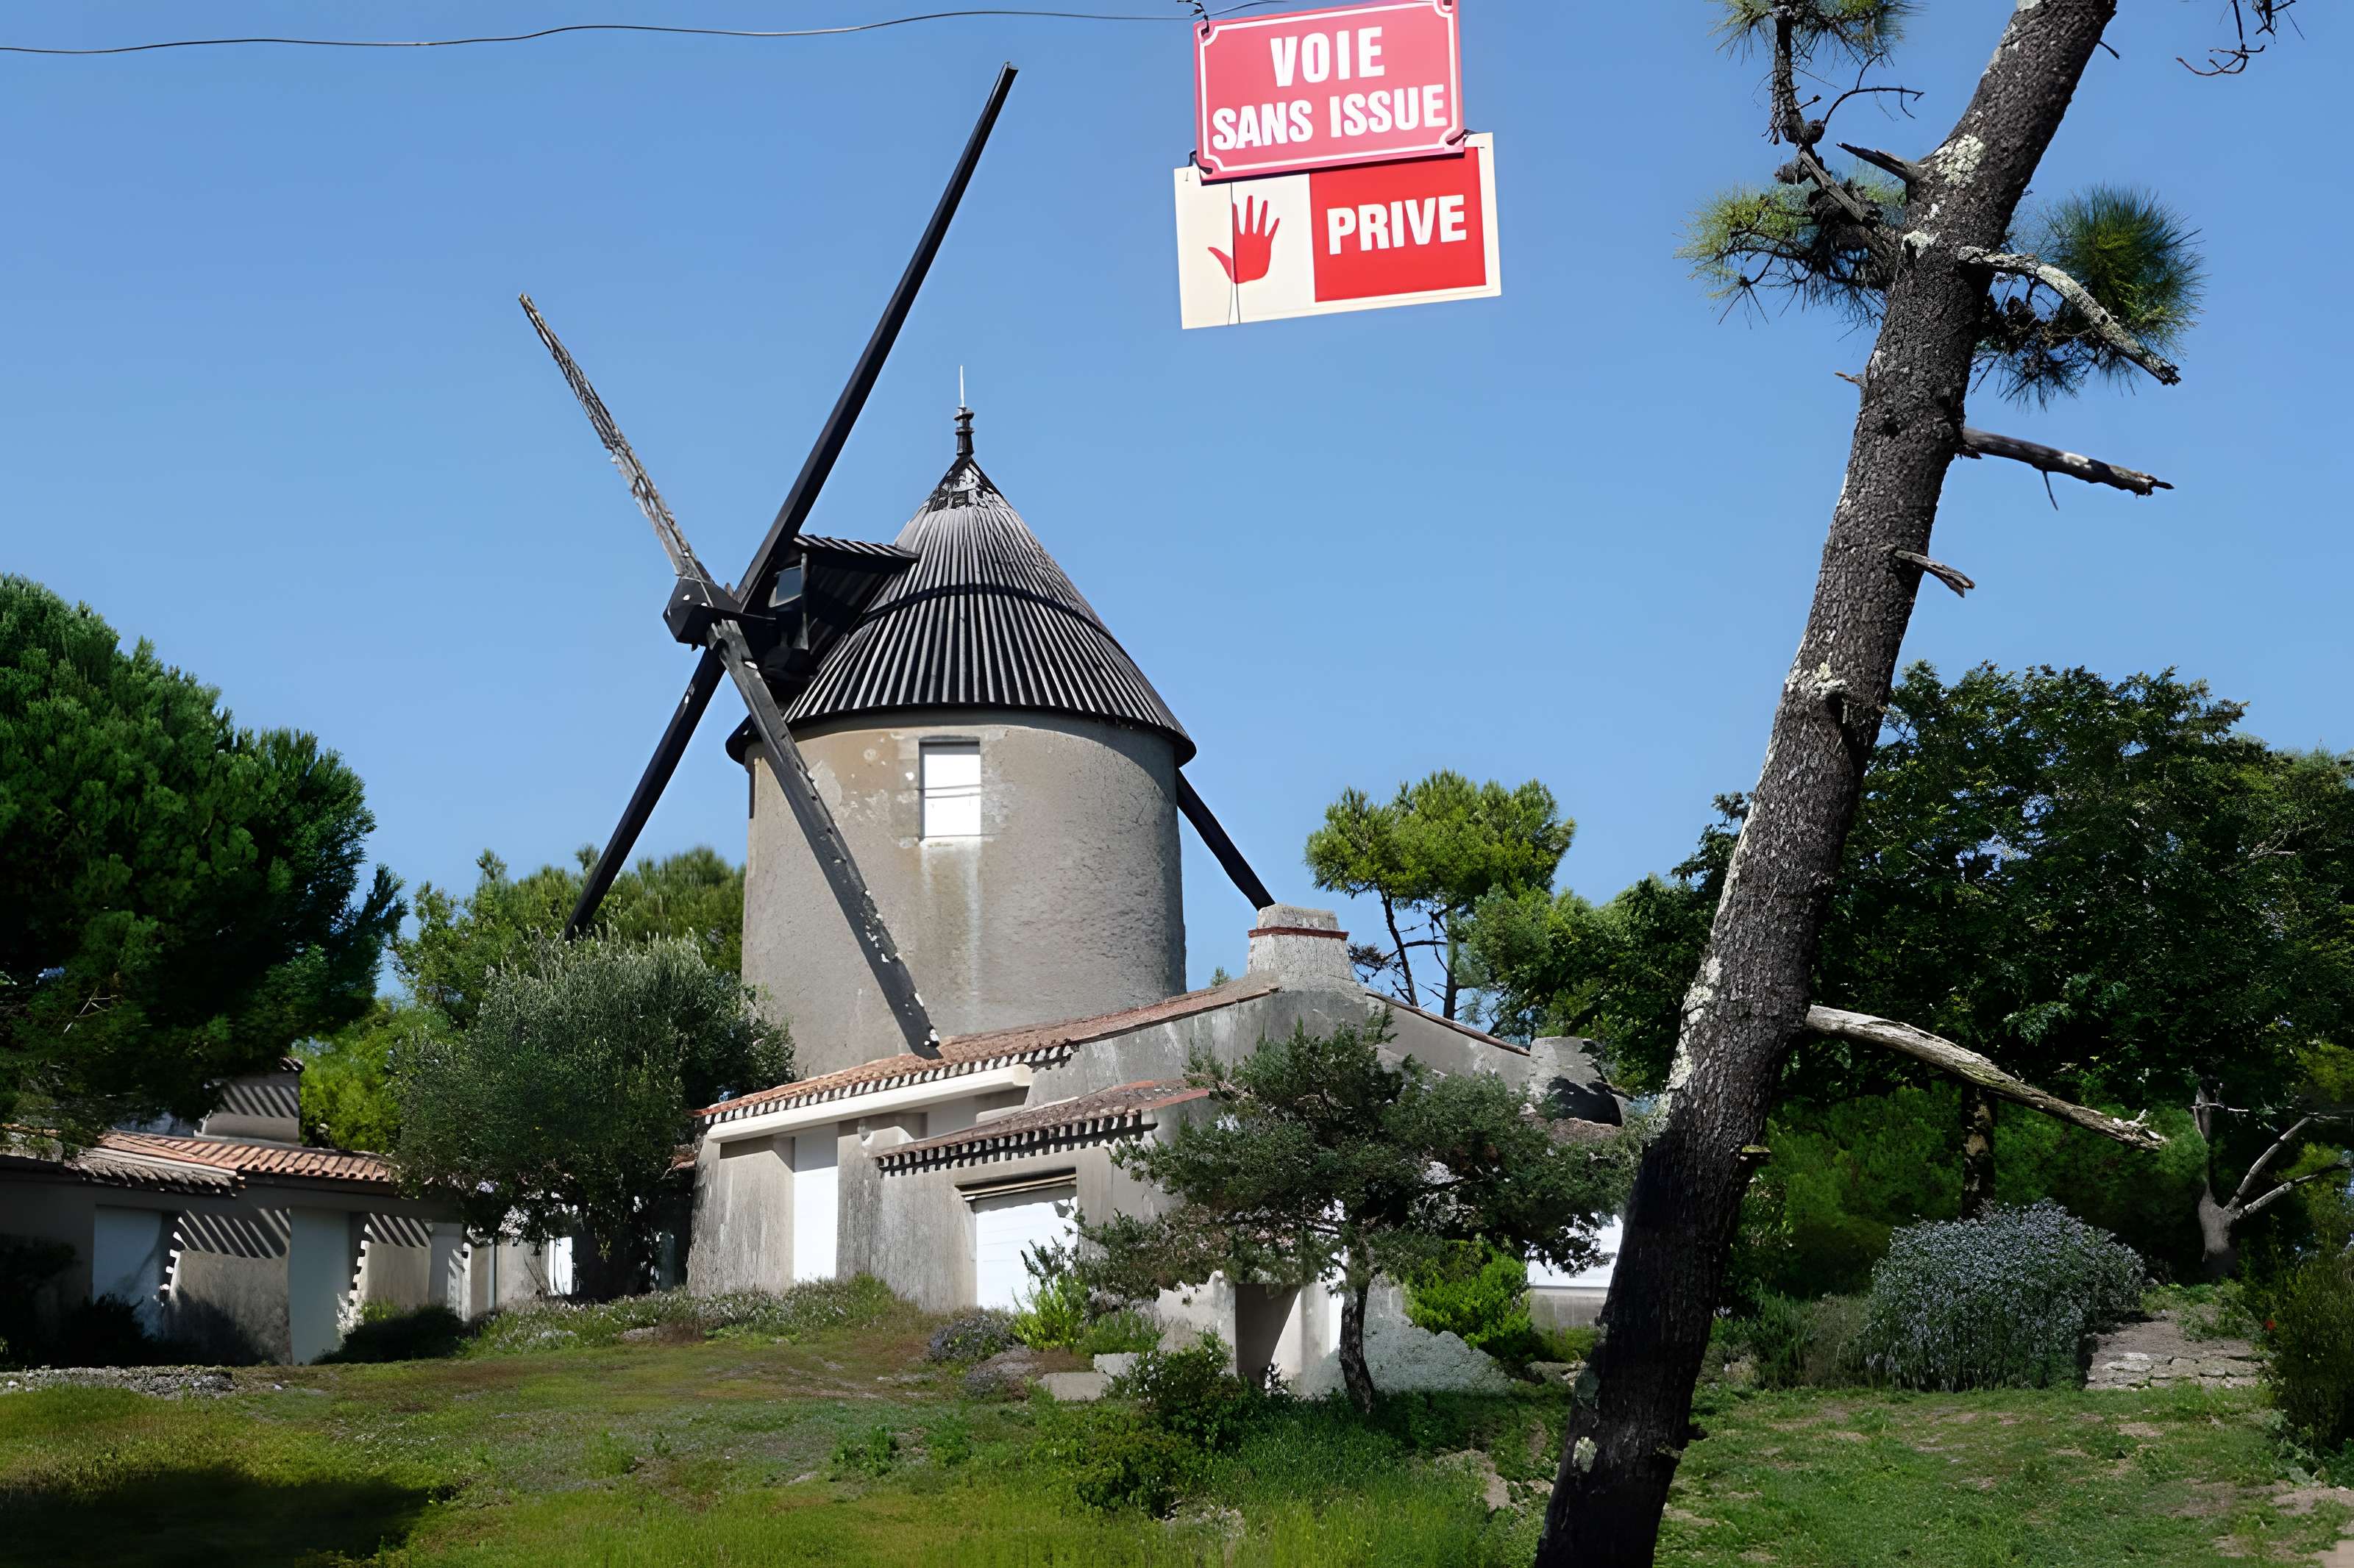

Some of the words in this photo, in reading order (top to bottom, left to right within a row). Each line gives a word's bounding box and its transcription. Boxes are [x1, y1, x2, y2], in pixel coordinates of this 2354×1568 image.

[1270, 26, 1385, 87] VOIE
[1212, 100, 1313, 150] SANS
[1329, 85, 1448, 138] ISSUE
[1326, 194, 1466, 254] PRIVE
